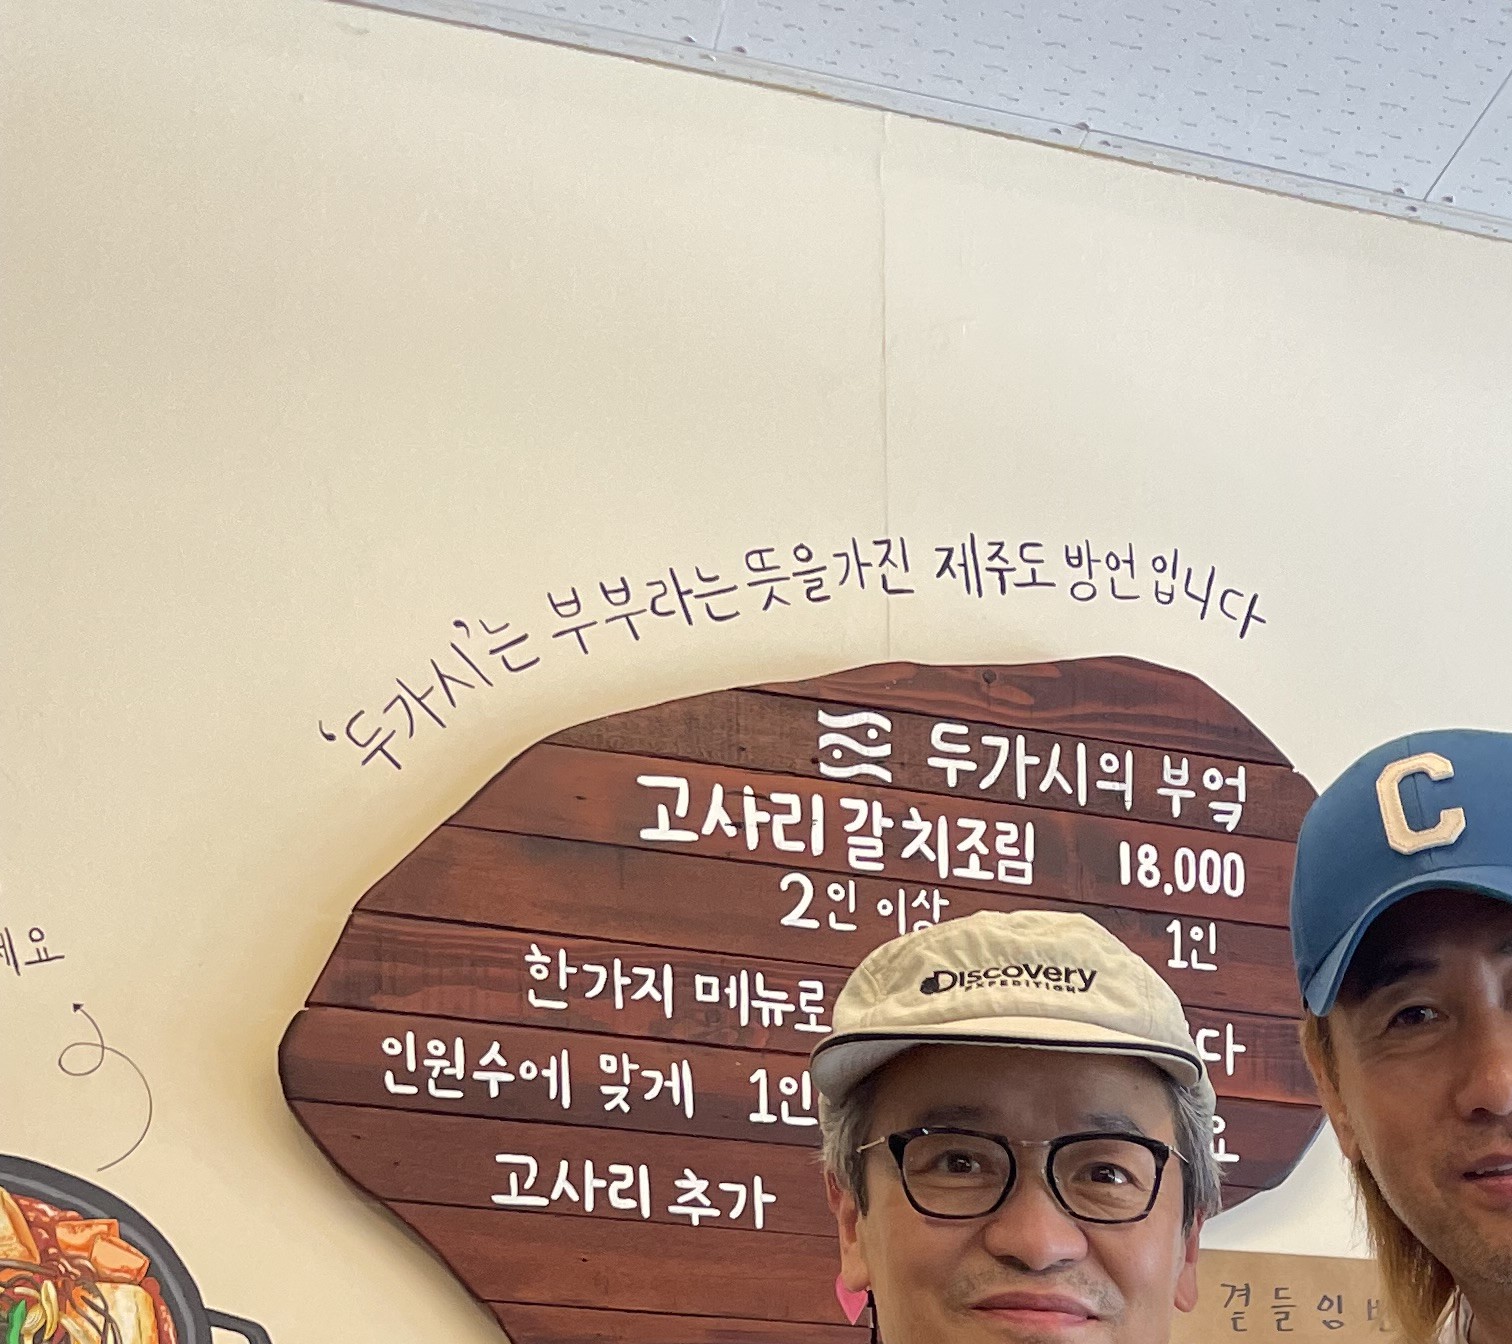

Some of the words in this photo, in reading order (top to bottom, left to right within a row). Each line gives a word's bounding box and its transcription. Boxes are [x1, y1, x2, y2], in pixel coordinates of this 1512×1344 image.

[926, 720, 1134, 812] 두가시의
[1156, 754, 1247, 833] 부엌
[1375, 752, 1467, 856] C
[636, 774, 825, 858] 고사리
[839, 797, 1036, 886] 갈치조림
[779, 871, 858, 932] 2인
[1166, 919, 1218, 971] 1인
[523, 943, 675, 1019] 한가지
[693, 969, 833, 1034] 메뉴로
[381, 1030, 572, 1110] 인원수에
[598, 1052, 695, 1119] 맞게
[748, 1067, 819, 1127] 1인
[491, 1152, 651, 1220] 고사리
[667, 1167, 777, 1231] 추가
